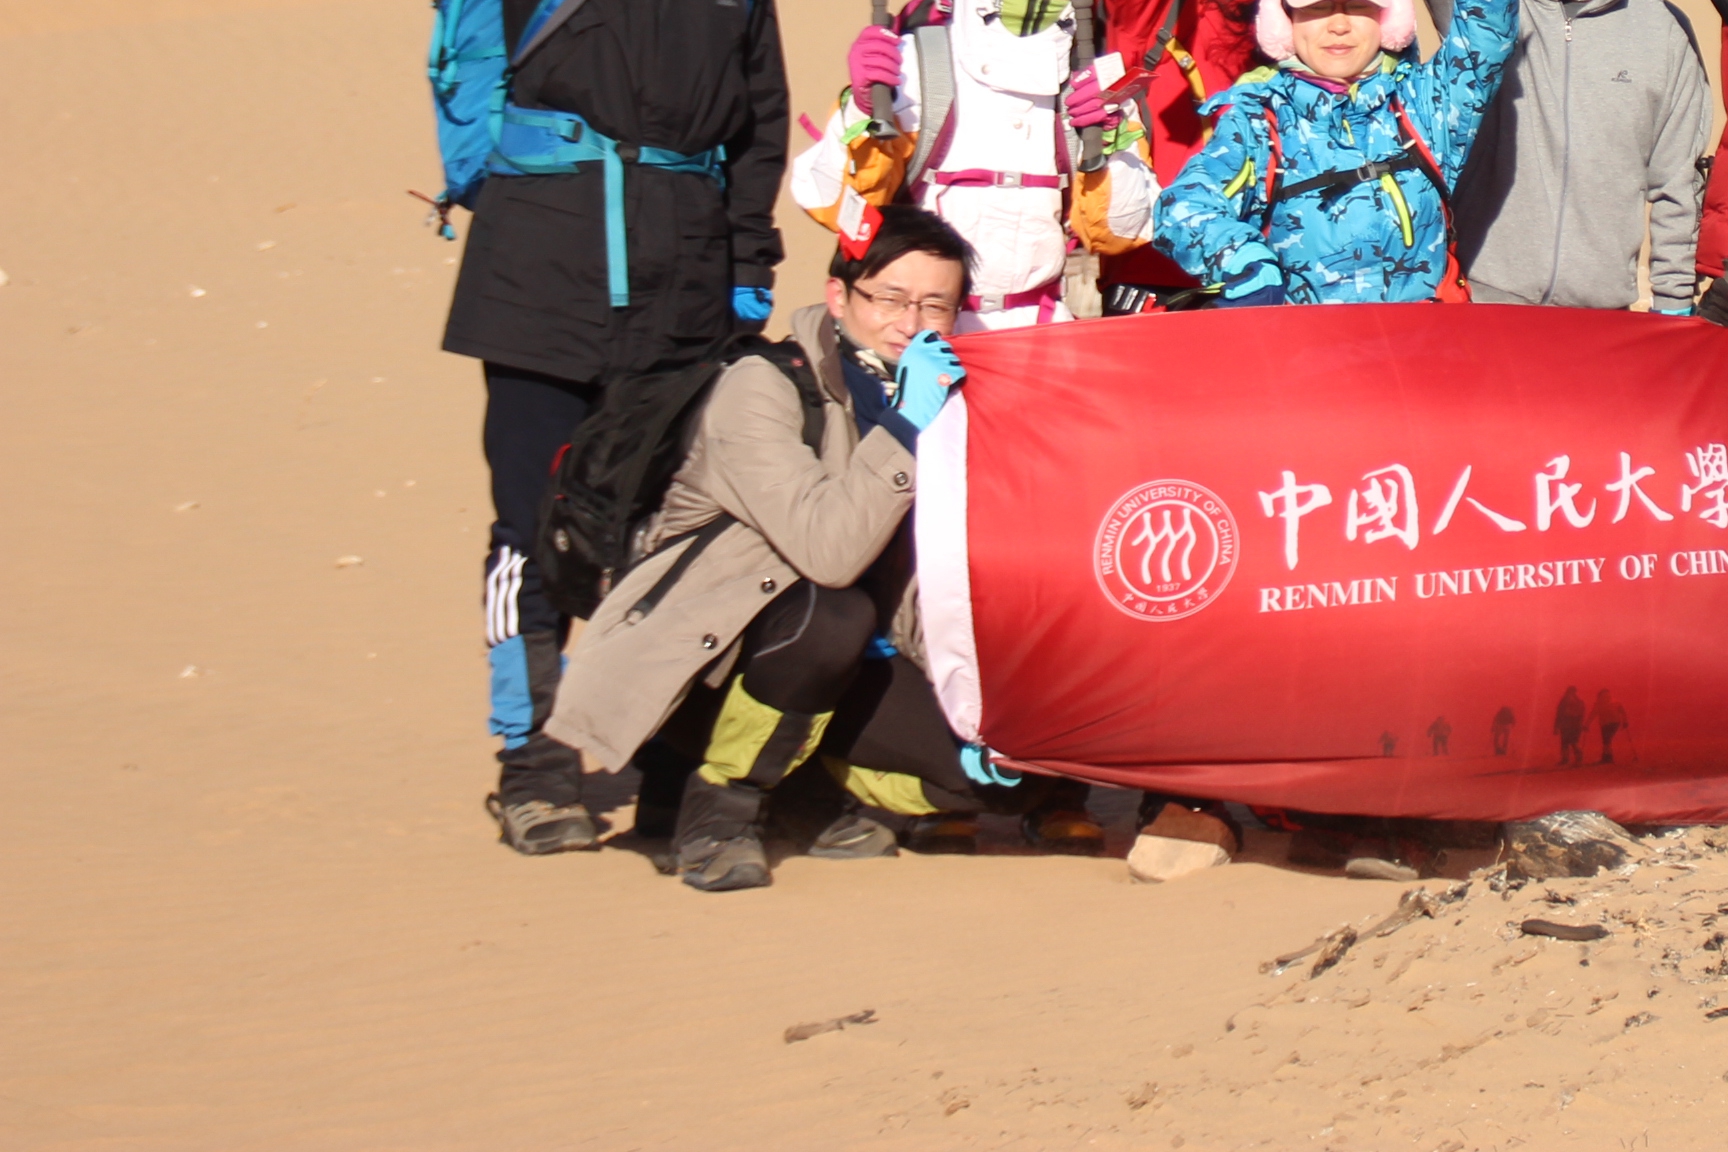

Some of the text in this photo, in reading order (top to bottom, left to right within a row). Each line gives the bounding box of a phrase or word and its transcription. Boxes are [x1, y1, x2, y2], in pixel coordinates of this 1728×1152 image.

[1101, 486, 1233, 575] RENMIN UNIVERSITY OF CHINA
[1156, 582, 1181, 593] 1937
[1258, 576, 1398, 613] RENMIN
[1415, 557, 1606, 599] UNIVERSITY
[1619, 553, 1658, 581] OF
